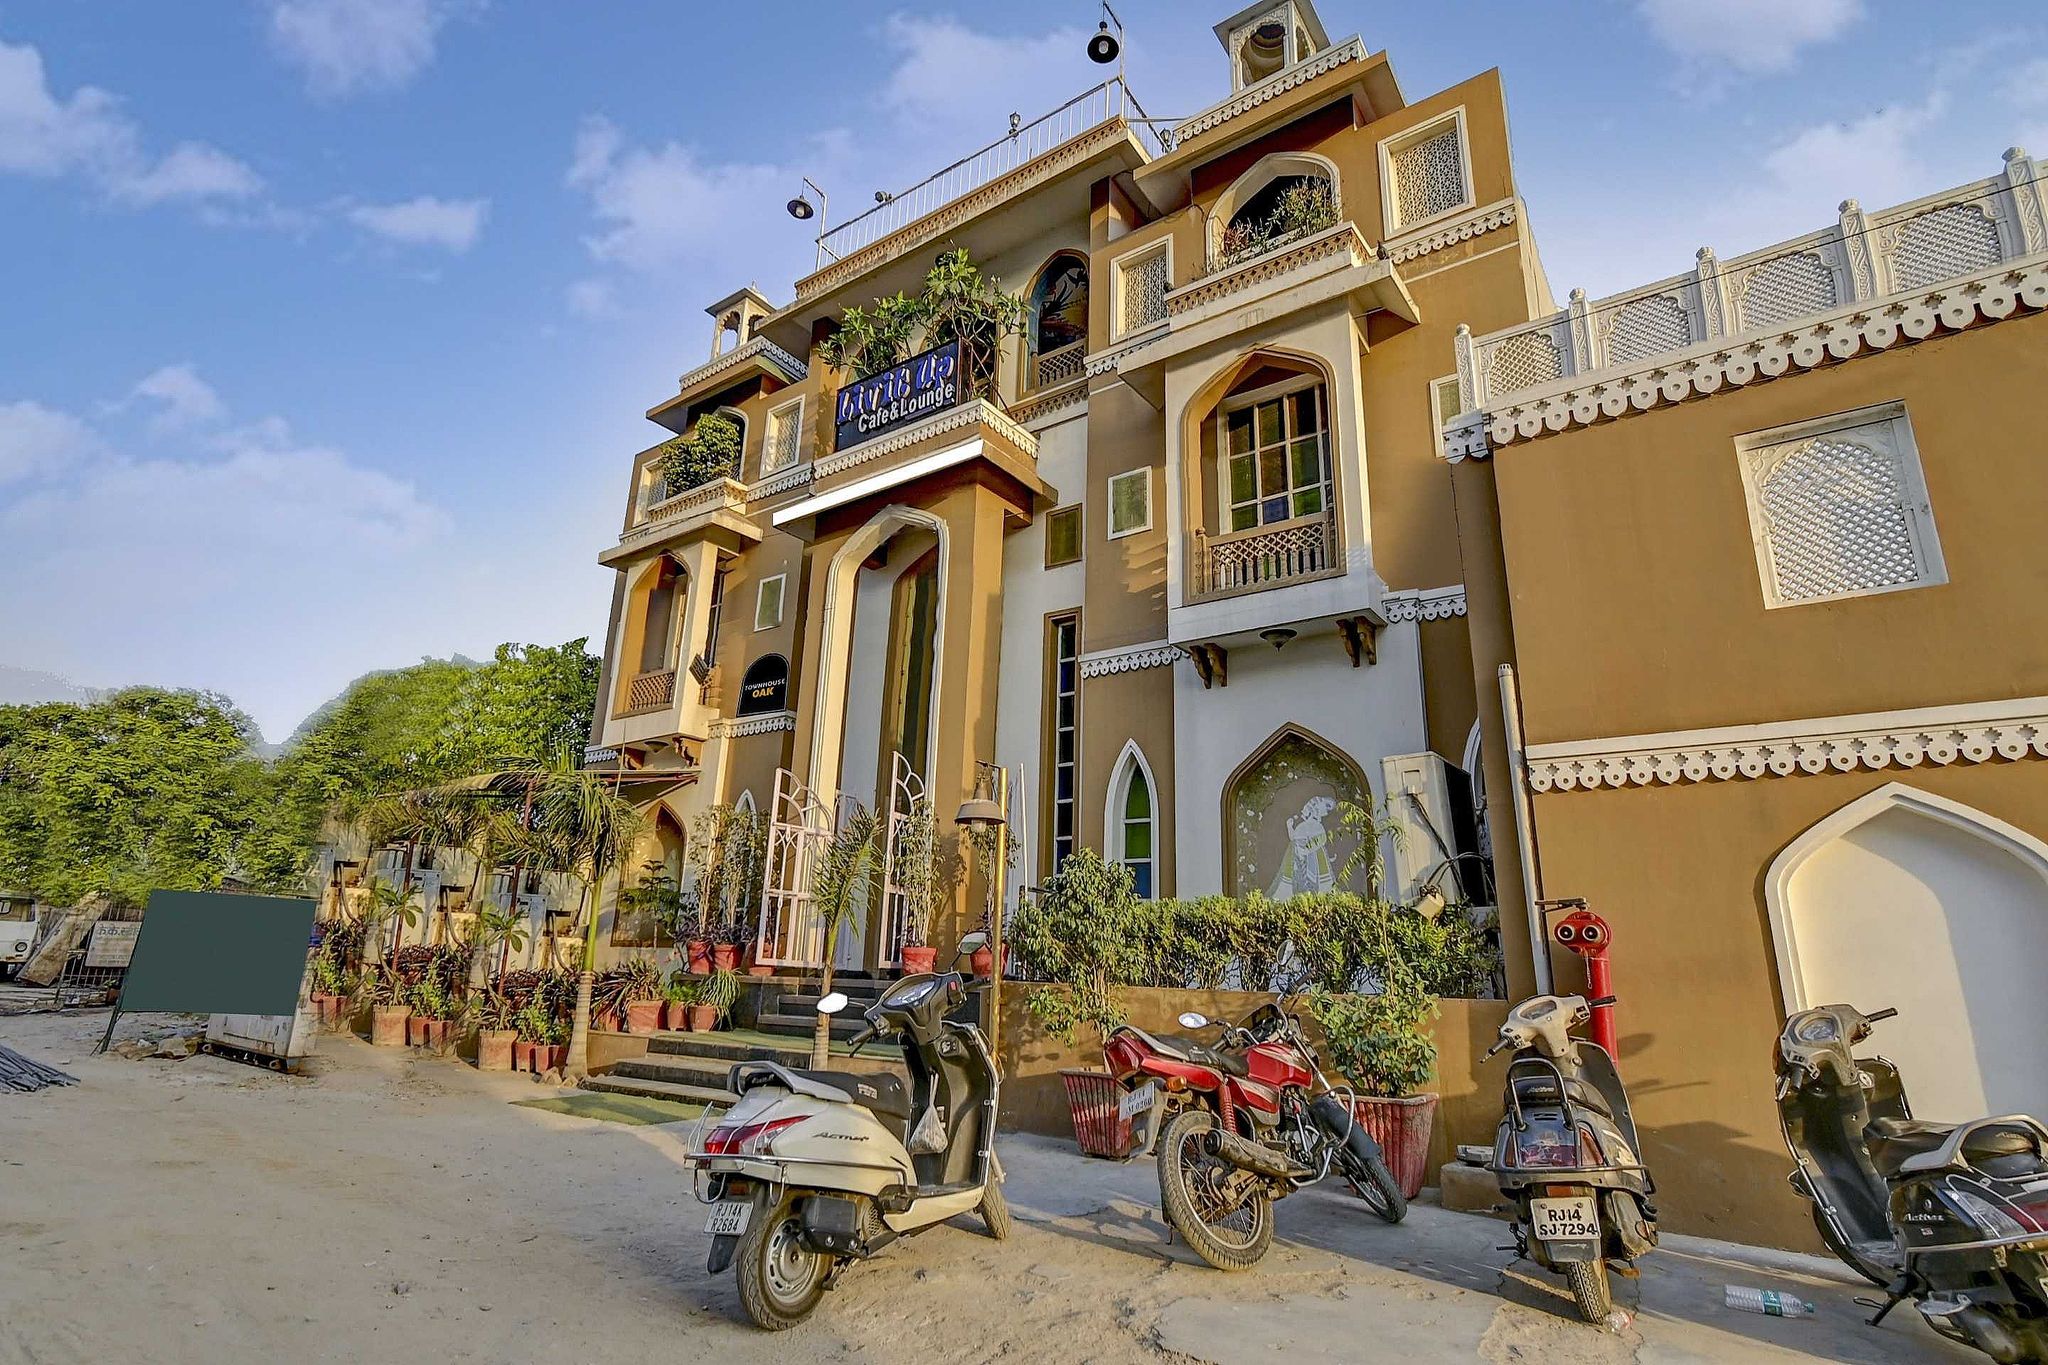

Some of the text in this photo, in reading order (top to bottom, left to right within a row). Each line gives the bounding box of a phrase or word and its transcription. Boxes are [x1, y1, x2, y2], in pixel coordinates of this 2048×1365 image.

[745, 678, 786, 690] TOWNHOUSE
[752, 687, 775, 698] OAK
[1547, 1208, 1582, 1221] RJ14
